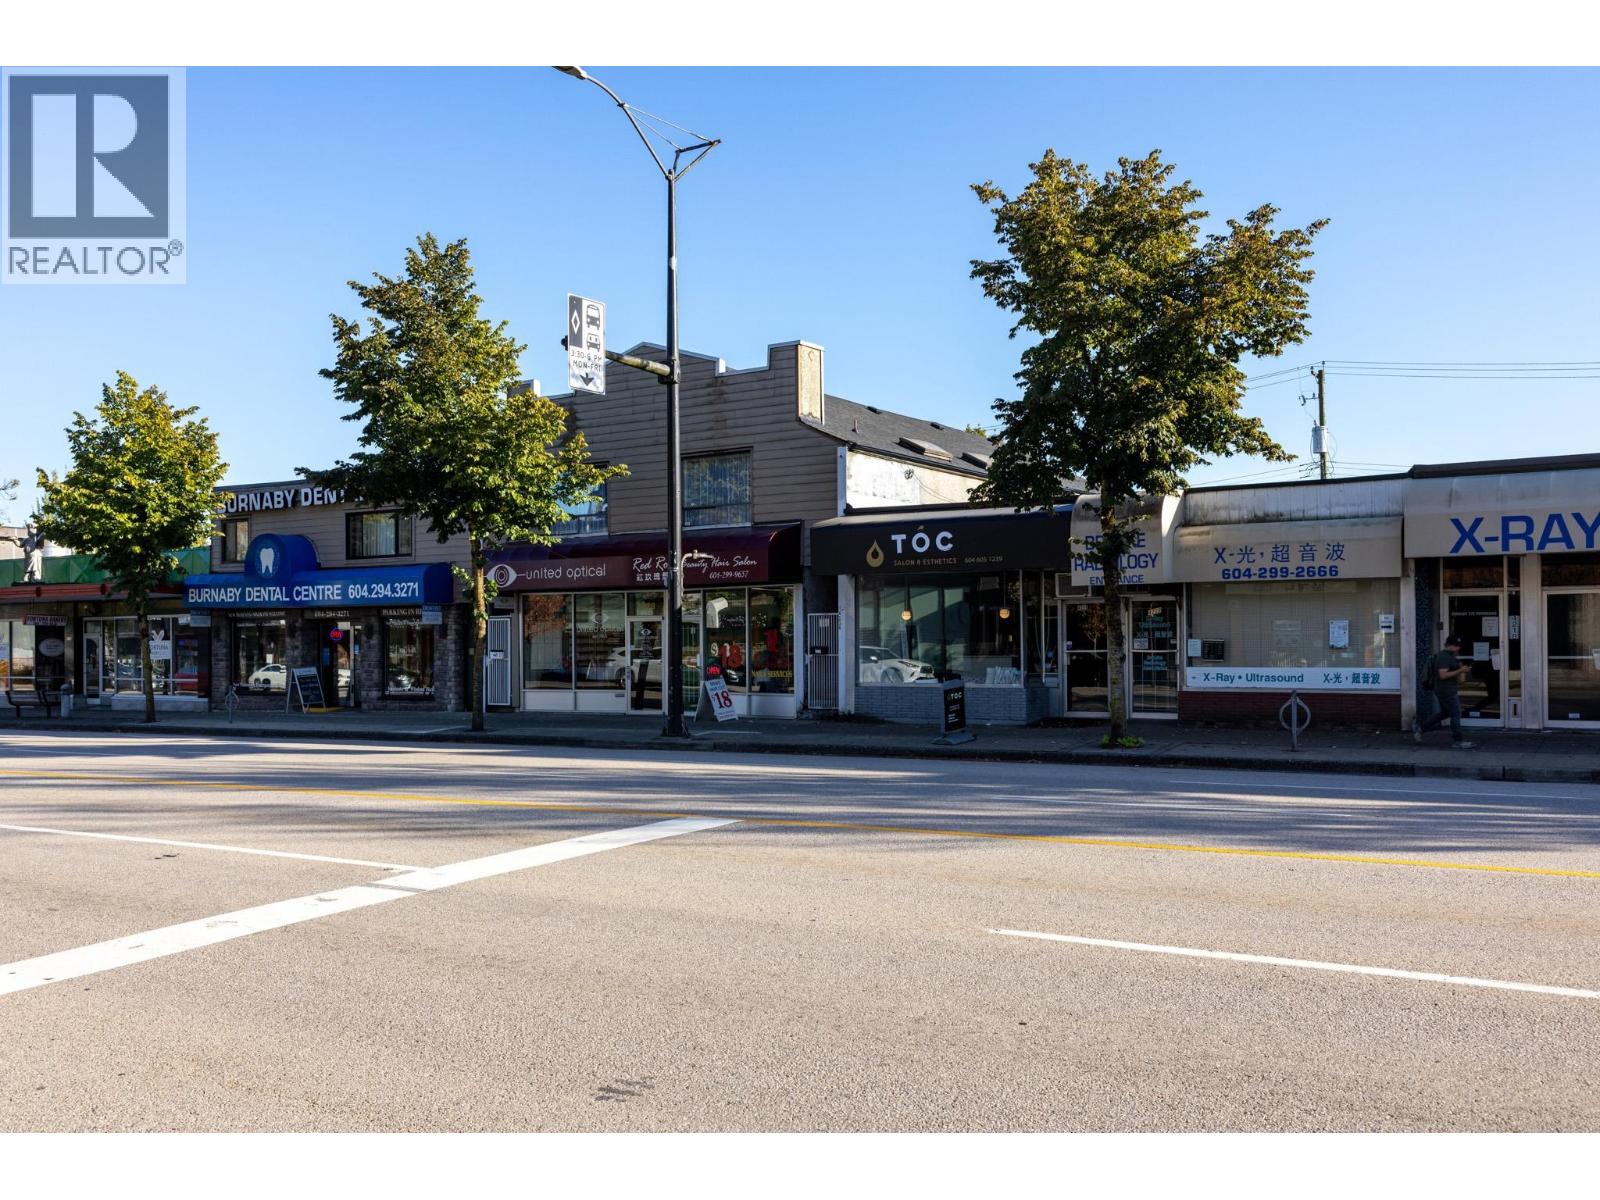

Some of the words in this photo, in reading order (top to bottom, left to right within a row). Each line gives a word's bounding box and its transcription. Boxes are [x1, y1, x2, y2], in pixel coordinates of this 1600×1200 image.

[573, 360, 601, 372] MON-FRI
[1450, 512, 1600, 553] X-RAY
[633, 557, 652, 571] Red
[710, 556, 730, 568] Hair
[732, 556, 758, 567] Salon
[923, 557, 957, 565] ESTHETICS
[526, 566, 561, 580] united
[566, 562, 606, 578] optical
[1222, 565, 1339, 579] 604-299-2666
[189, 586, 241, 602] BURNABY
[246, 586, 289, 601] DENTAL
[293, 584, 341, 600] CENTRE
[348, 582, 419, 599] 604.294.3271
[1203, 673, 1235, 684] X-Ray
[1246, 673, 1304, 682] Ultrasound
